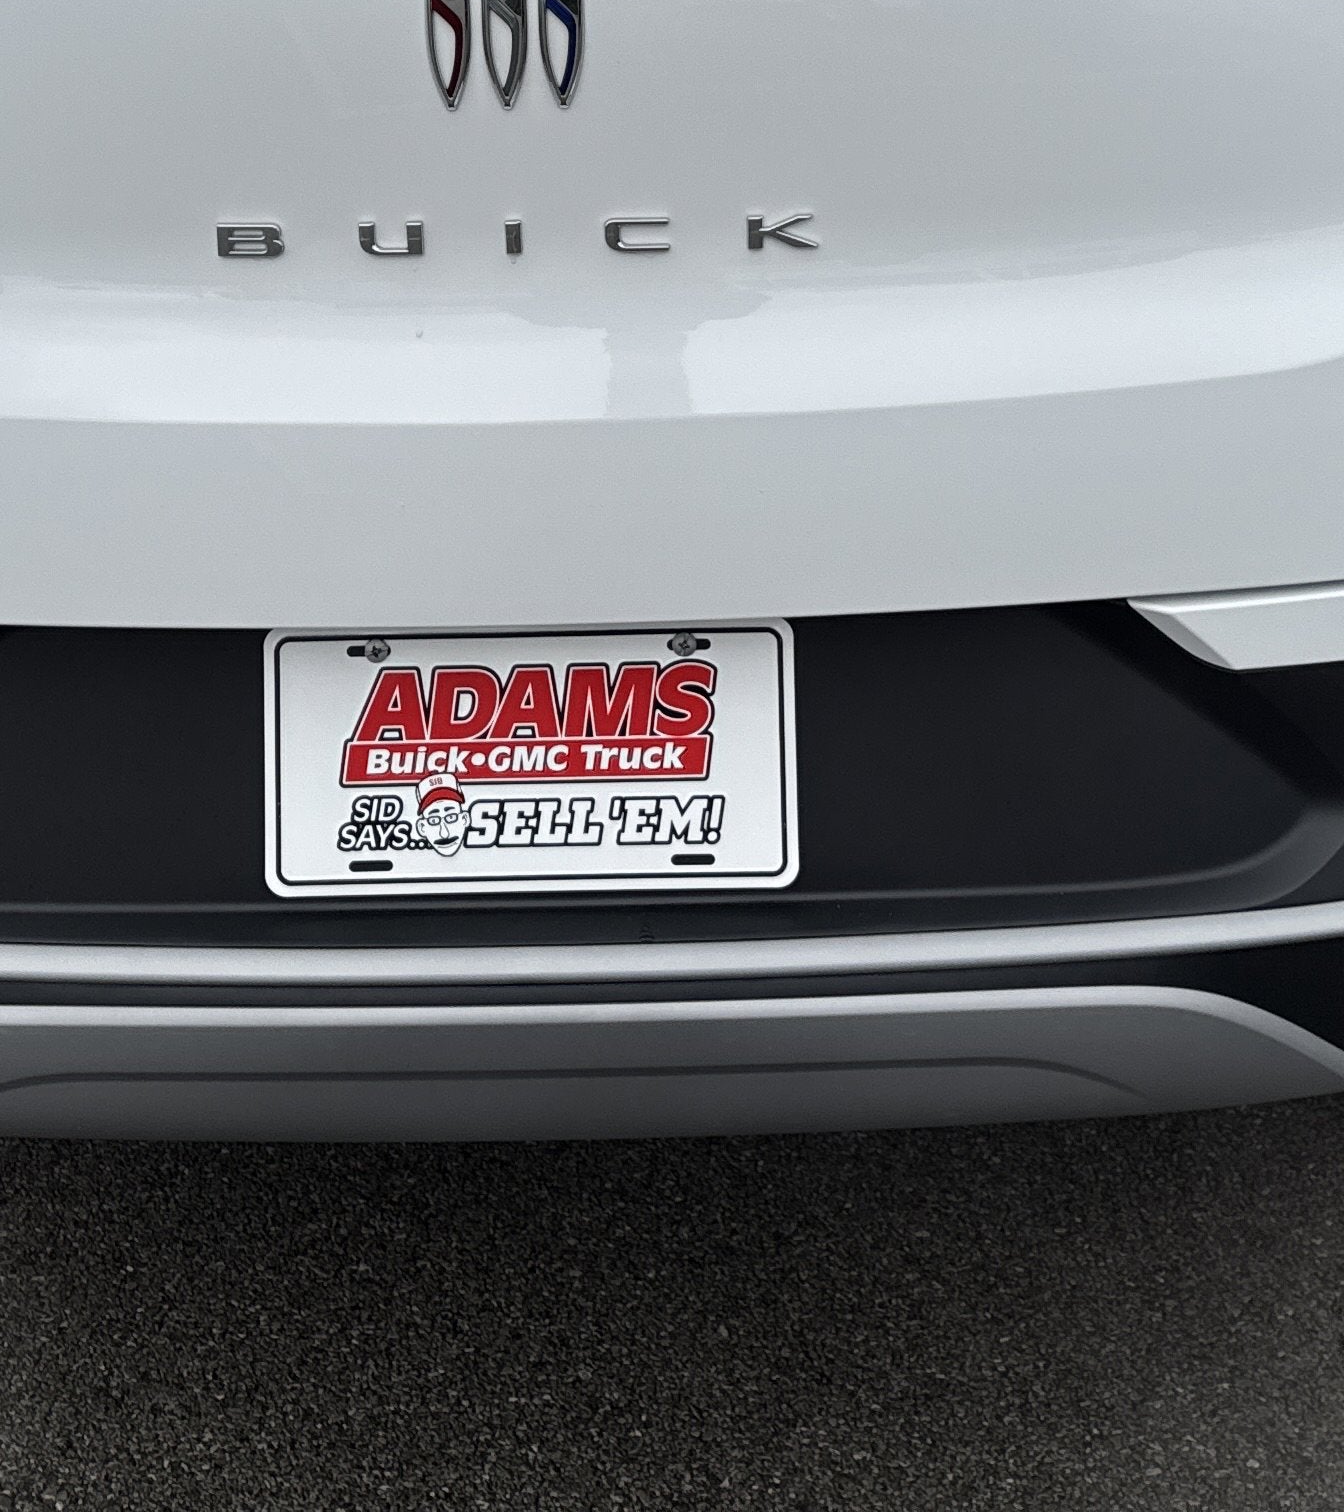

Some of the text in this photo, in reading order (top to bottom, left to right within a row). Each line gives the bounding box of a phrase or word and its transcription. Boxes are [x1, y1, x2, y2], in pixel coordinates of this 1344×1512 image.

[216, 213, 819, 258] BUICK
[351, 659, 718, 743] ADAMS
[580, 740, 687, 772] Truck
[352, 795, 404, 823] SID
[464, 795, 726, 848] SELL 'EM!
